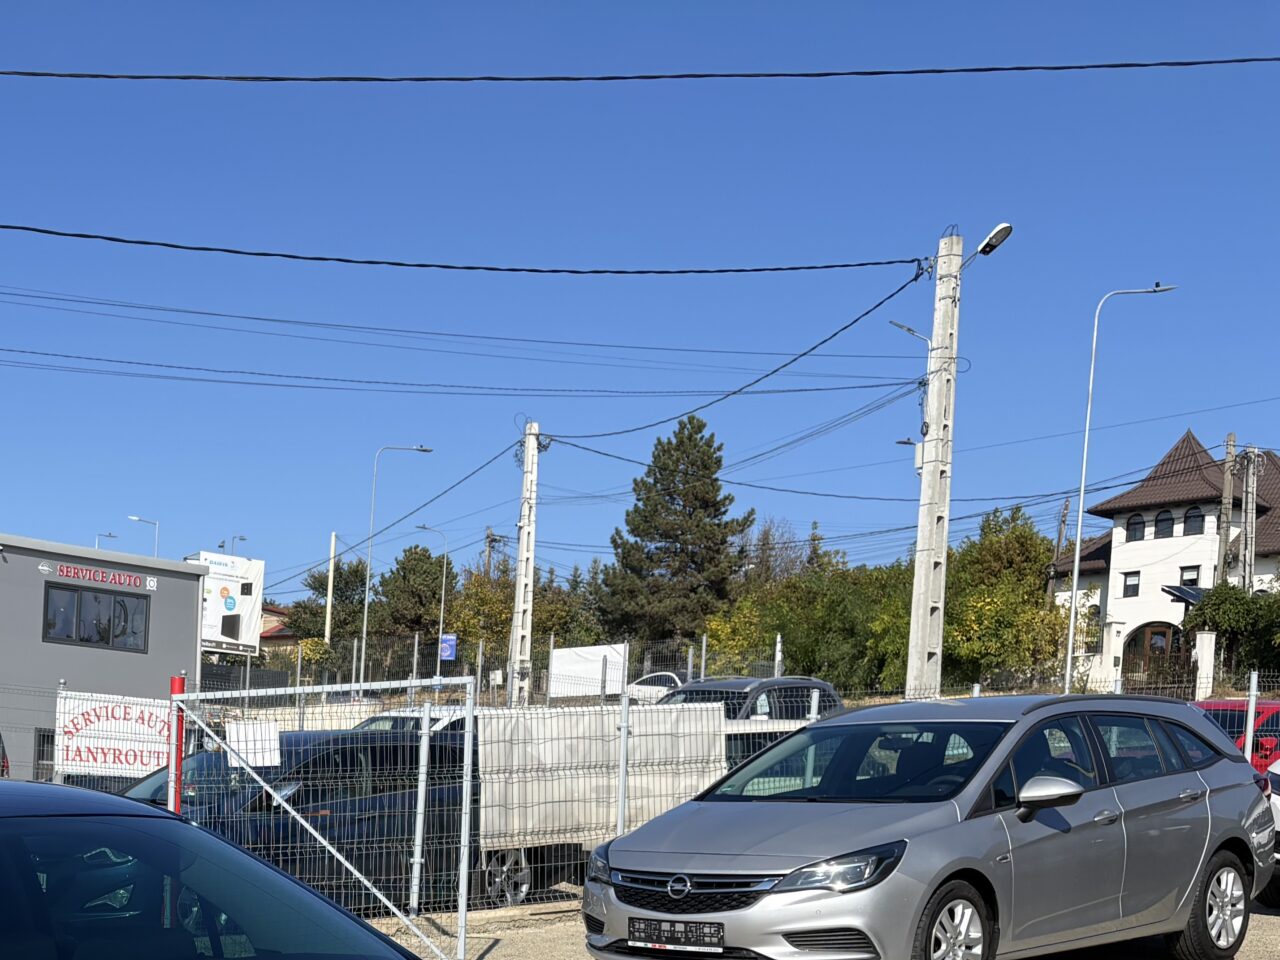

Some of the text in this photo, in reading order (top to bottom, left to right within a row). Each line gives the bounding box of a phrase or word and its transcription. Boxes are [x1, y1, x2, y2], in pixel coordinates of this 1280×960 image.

[57, 564, 142, 588] SERVICE AUTO
[63, 704, 171, 742] SERVICE AUT
